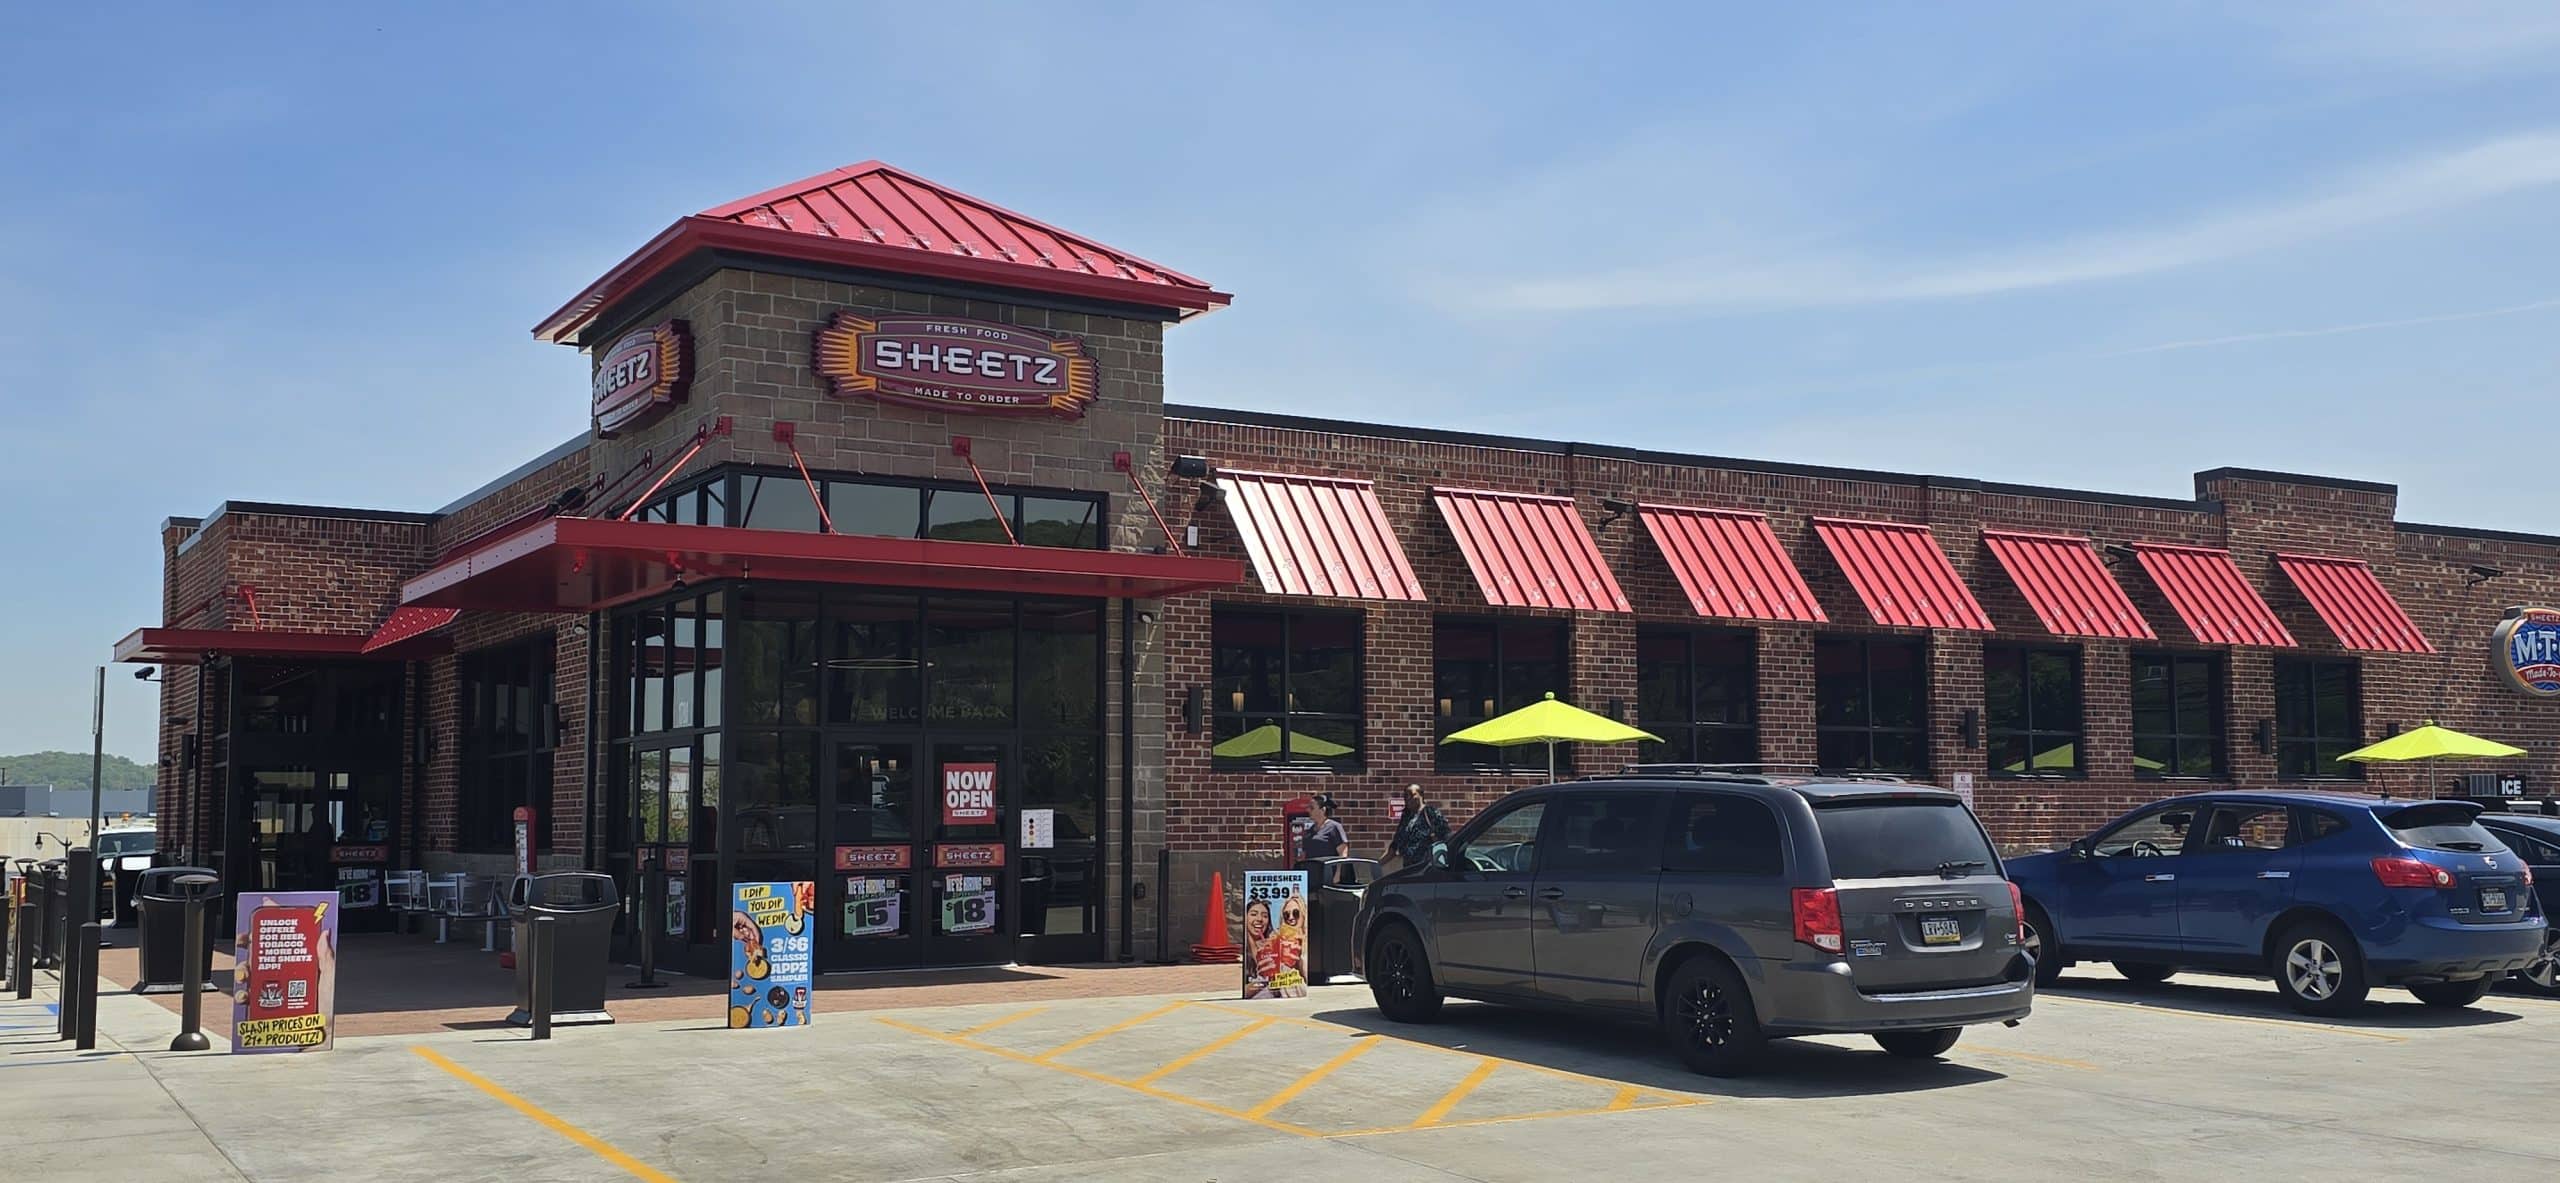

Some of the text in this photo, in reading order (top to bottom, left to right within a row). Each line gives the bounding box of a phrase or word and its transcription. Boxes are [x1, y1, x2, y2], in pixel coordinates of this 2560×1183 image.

[926, 325, 1008, 340] FRESH FOOD
[876, 340, 1057, 384] SHEETZ
[914, 387, 1019, 404] MADE TO ORDER
[872, 704, 957, 721] WELCME
[946, 771, 993, 790] NOW
[2501, 780, 2521, 795] ICE
[946, 790, 993, 808] OPEN
[849, 853, 897, 861] SHEETZ
[946, 851, 992, 860] SHEETZ
[744, 887, 763, 898] I DIP
[1250, 887, 1290, 899] $3.99
[750, 899, 783, 912] YOU DIP
[1904, 899, 1979, 908] DODGE
[847, 900, 889, 928] $15
[946, 898, 986, 924] $18
[758, 912, 787, 926] WE DIP
[280, 933, 306, 941] BEER,
[259, 941, 304, 949] TOBACCO
[771, 937, 809, 953] 3/$6
[278, 955, 312, 963] SHEETZ
[771, 953, 809, 962] CLASSIC
[771, 962, 808, 974] APPZ
[240, 1015, 320, 1035] SLASH PRICES ON
[244, 1030, 320, 1046] 21+ PRODUCTZ!
